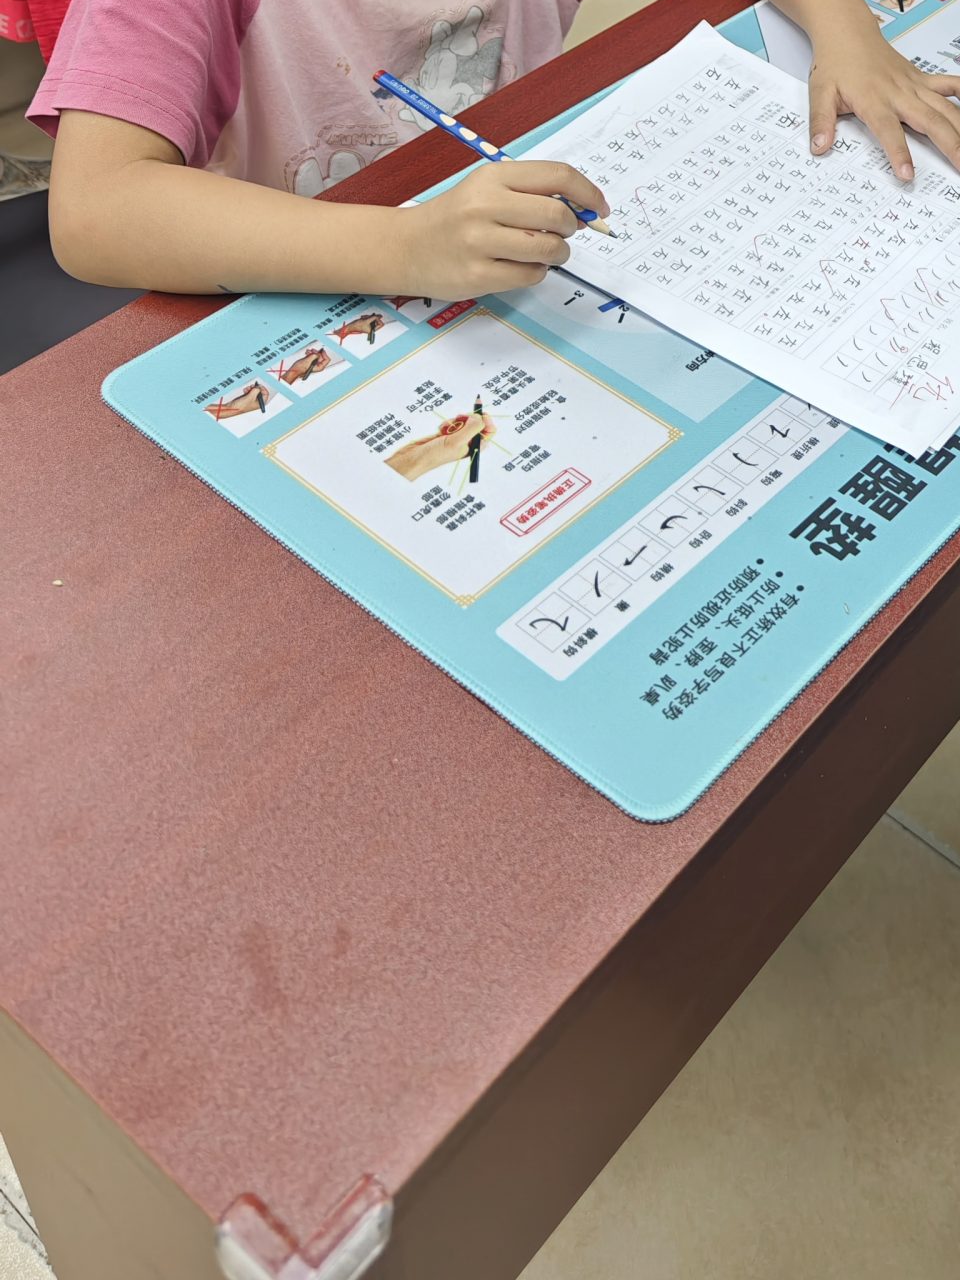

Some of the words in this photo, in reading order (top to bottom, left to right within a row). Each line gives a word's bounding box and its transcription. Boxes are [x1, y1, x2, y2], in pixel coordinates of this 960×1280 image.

[571, 288, 585, 299] 3
[617, 302, 630, 313] 2
[410, 378, 435, 396] 贴掌
[479, 362, 519, 392] 节中点处
[488, 367, 527, 397] 指第一关
[488, 372, 536, 408] 笔头靠着中
[403, 384, 444, 413] 手指不可
[511, 386, 559, 423] 轻触或微分
[362, 417, 405, 448] 手腕根部
[500, 441, 541, 473] 弯曲二段
[518, 447, 552, 474] 两指均
[788, 434, 820, 462] 横折提
[758, 466, 783, 488] 弯钩
[408, 489, 452, 523] 勿靠虎口
[418, 483, 444, 503] 底部
[513, 476, 576, 526] 正确执笔姿势
[723, 496, 749, 518] 斜钩
[433, 492, 476, 526] 食指根部
[443, 498, 486, 533] 笔杆斜靠
[686, 527, 713, 550] 卧钩
[648, 560, 675, 584] 横钩
[646, 563, 761, 667] 预防近视防止驼背
[560, 625, 600, 659] 横斜钩
[636, 576, 781, 708] 防止低头、歪脖、趴桌
[658, 589, 801, 724] 有效矫正不良写字姿势
